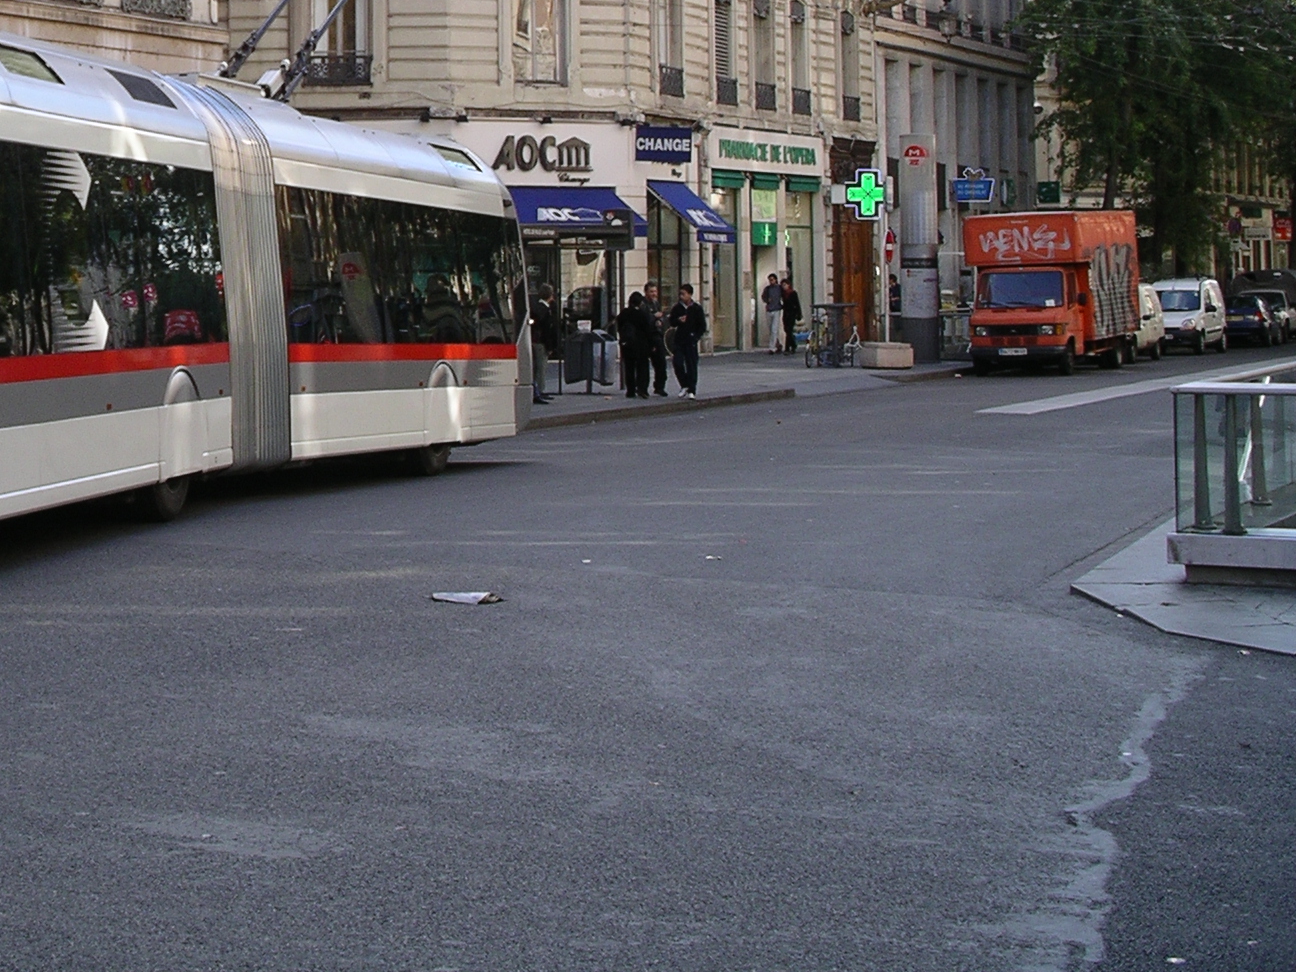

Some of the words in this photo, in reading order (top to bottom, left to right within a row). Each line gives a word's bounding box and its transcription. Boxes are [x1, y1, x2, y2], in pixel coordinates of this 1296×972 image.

[492, 135, 556, 172] AOC
[636, 137, 691, 152] CHANGE
[770, 144, 781, 163] DE
